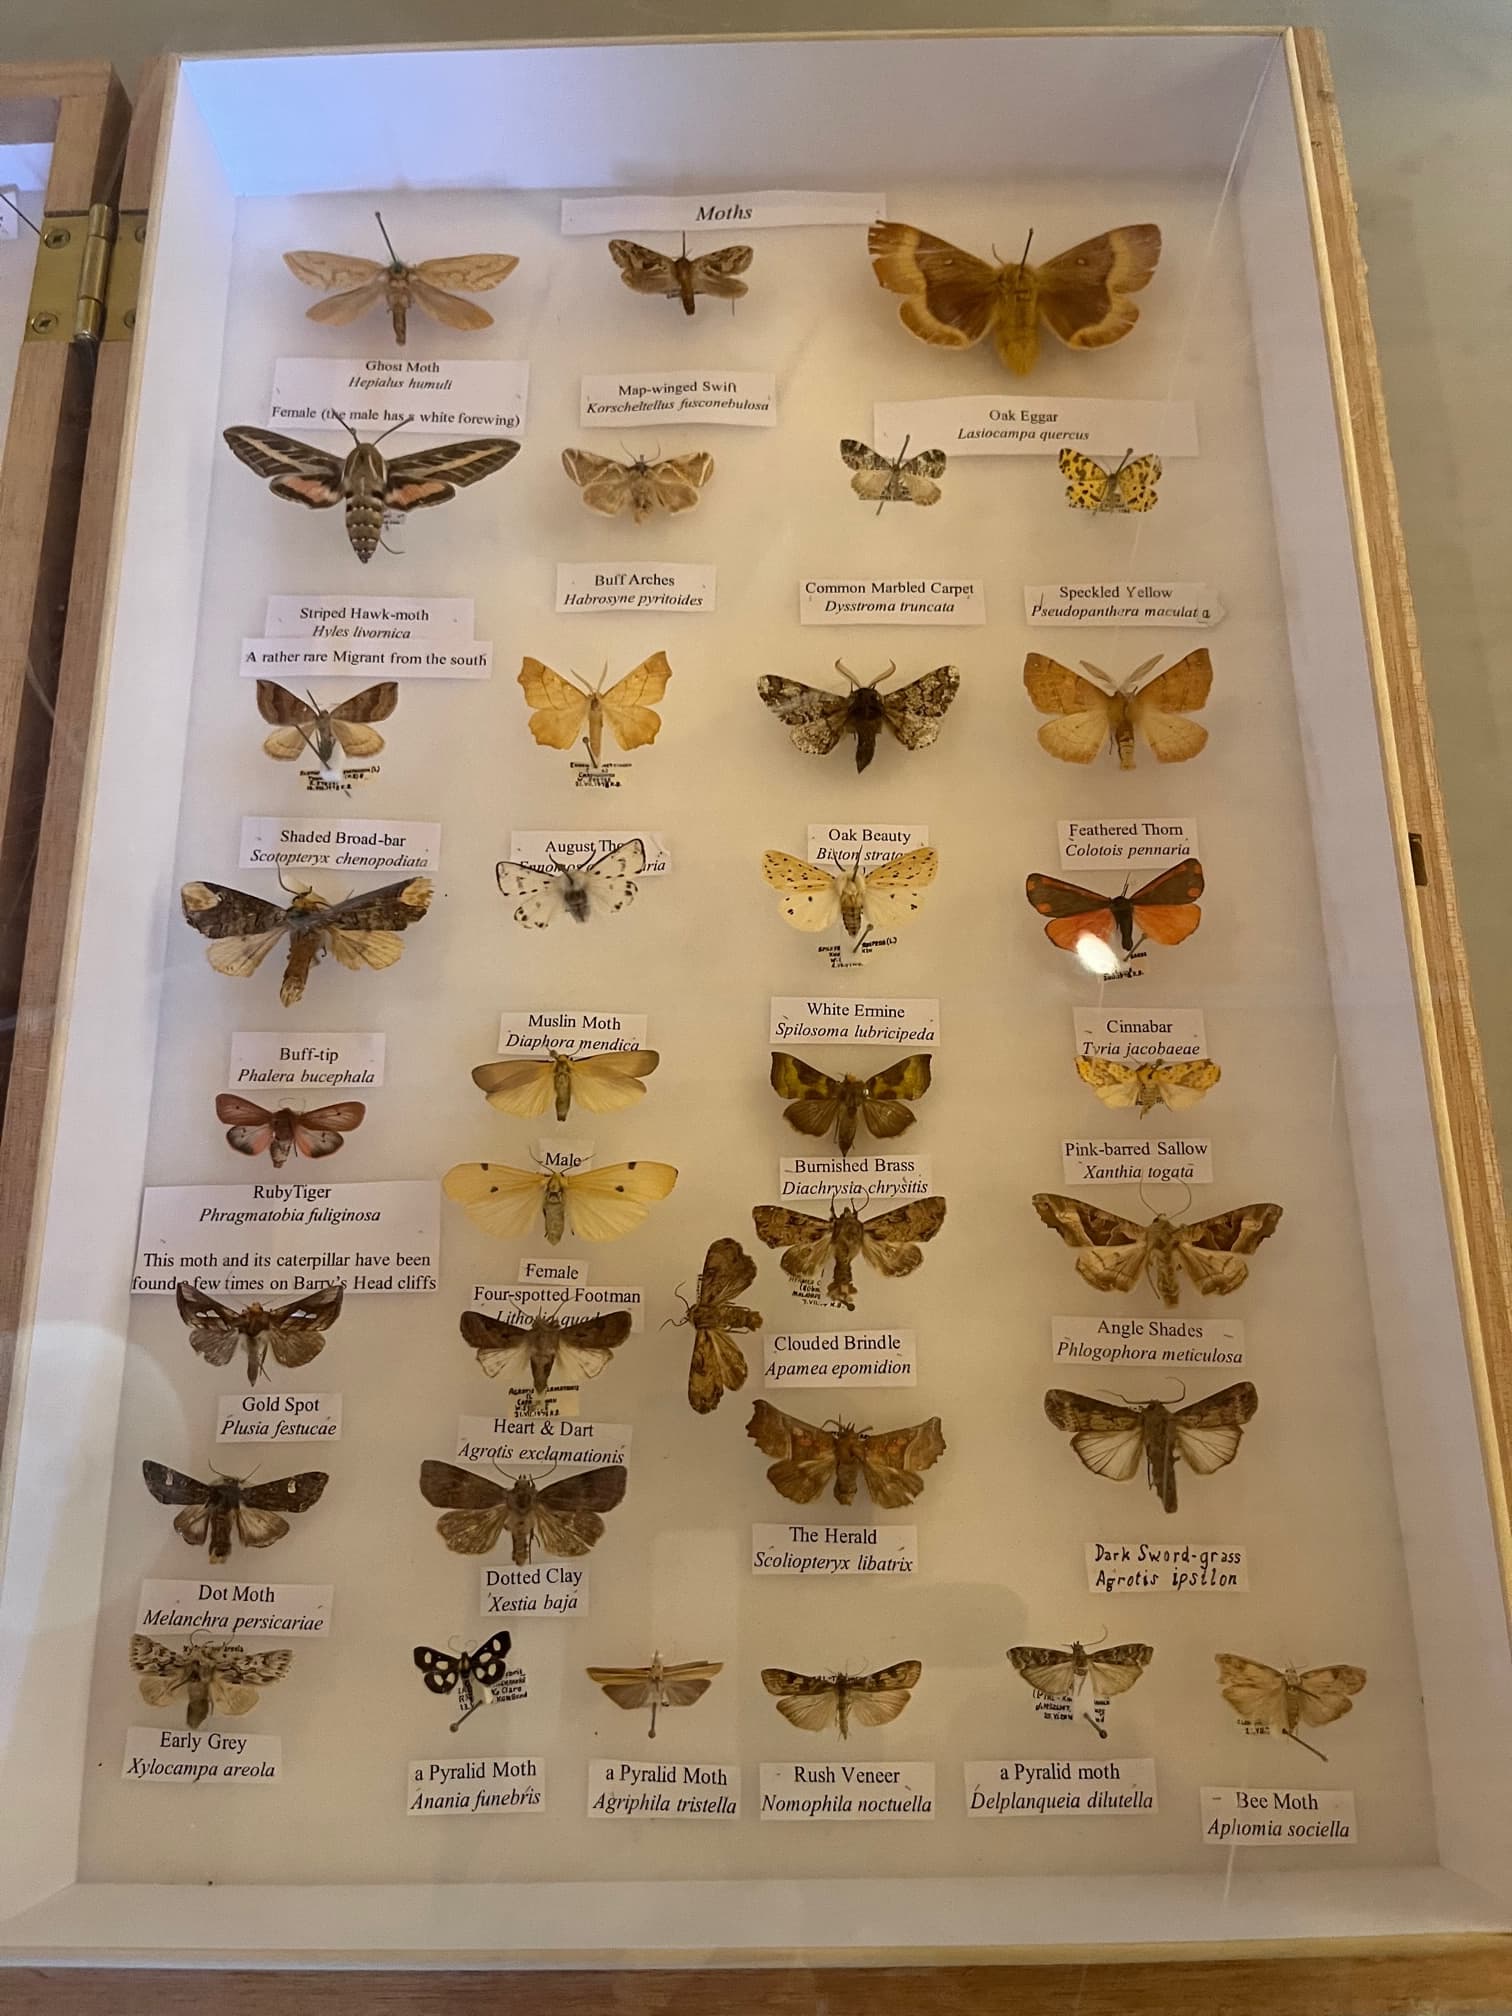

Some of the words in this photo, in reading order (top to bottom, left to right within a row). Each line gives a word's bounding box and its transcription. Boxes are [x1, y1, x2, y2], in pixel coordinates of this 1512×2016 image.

[696, 204, 752, 221] Moths
[366, 361, 402, 373] Ghost
[407, 362, 440, 373] Moth
[349, 377, 404, 390] Hepialus
[409, 378, 452, 390] humuli
[619, 382, 697, 398] Map-winged
[702, 382, 736, 393] Swift
[587, 399, 675, 413] Korscheltellus
[678, 398, 769, 411] fusconebulosa
[272, 406, 316, 418] Female
[350, 409, 378, 420] male
[421, 412, 454, 423] white
[458, 413, 520, 428] forewing)
[989, 410, 1016, 422] Oak
[1021, 411, 1058, 424] Eggar
[958, 428, 1036, 442] Lasiocampa
[1039, 429, 1089, 442] quercus
[595, 574, 627, 586] Buff
[629, 574, 675, 586] Arches
[805, 582, 865, 593] Common
[871, 582, 926, 593] Marbled
[931, 582, 973, 597] Carpet
[1060, 586, 1120, 600] Speckled
[1127, 586, 1172, 598] Yellow
[564, 594, 635, 606] Habrosyne
[638, 594, 703, 606] pyritoides
[825, 600, 895, 614] Dysstroma
[900, 601, 954, 612] truncata
[300, 607, 346, 620] Striped
[350, 608, 429, 621] Hawk-moth
[1032, 605, 1139, 620] Pseudopanthera
[312, 625, 349, 639] Hyles
[353, 626, 411, 639] livornica
[246, 652, 256, 662] A
[262, 651, 300, 662] rather
[303, 653, 327, 662] rare
[333, 651, 384, 666] Migrant
[391, 652, 422, 664] from
[426, 653, 445, 665] the
[451, 655, 487, 666] south
[829, 829, 857, 841] Oak
[862, 829, 911, 845] Beauty
[1069, 824, 1137, 836] Feathered
[1141, 823, 1183, 835] Thorn
[280, 830, 331, 843] Shaded
[336, 832, 406, 847] Broad-bar
[545, 841, 596, 855] August
[1066, 843, 1123, 857] Colotois
[1127, 844, 1190, 859] pennaria
[250, 850, 330, 865] Scotopteryx
[336, 852, 428, 869] chenopodiata
[808, 1002, 849, 1016] White
[855, 1004, 905, 1018] Ermine
[528, 1014, 576, 1027] Muslin
[583, 1016, 621, 1030] Moth
[1107, 1020, 1173, 1033] Cinnabar
[776, 1023, 849, 1038] Spilosoma
[854, 1025, 934, 1043] lubricipeda
[506, 1034, 575, 1050] Diaphora
[579, 1037, 639, 1051] mendica
[1123, 1042, 1200, 1058] jacobaeae
[280, 1047, 338, 1064] Buff-tip
[238, 1069, 295, 1082] Phalera
[301, 1069, 375, 1086] bucephala
[1065, 1142, 1150, 1156] Pink-barred
[1158, 1142, 1208, 1155] Sallow
[546, 1152, 582, 1166] Male
[795, 1159, 868, 1173] Burnished
[875, 1159, 915, 1172] Brass
[1083, 1165, 1142, 1179] Xanthia
[1148, 1167, 1194, 1181] togata
[782, 1181, 862, 1196] Diachrysia
[868, 1180, 928, 1197] chrysitis
[199, 1208, 304, 1225] Phragmatobia
[306, 1208, 381, 1225] fuliginosa
[144, 1253, 174, 1267] This
[180, 1255, 218, 1267] moth
[223, 1255, 248, 1267] and
[254, 1255, 271, 1267] its
[277, 1252, 350, 1270] caterpillar
[356, 1252, 390, 1267] have
[396, 1252, 430, 1266] been
[526, 1263, 578, 1279] Female
[132, 1276, 176, 1290] found
[194, 1276, 220, 1290] few
[226, 1276, 264, 1290] times
[270, 1281, 288, 1289] on
[354, 1276, 392, 1289] Head
[398, 1276, 436, 1289] cliffs
[474, 1287, 569, 1304] Four-spotted
[575, 1288, 640, 1303] Footman
[1097, 1320, 1143, 1338] Angle
[1149, 1322, 1203, 1337] Shades
[774, 1335, 839, 1351] Clouded
[844, 1335, 900, 1349] Brindle
[1058, 1342, 1157, 1362] Phlogophora
[1162, 1347, 1242, 1363] meticulosa
[765, 1361, 828, 1380] Apamea
[832, 1359, 910, 1378] epomidion
[242, 1396, 280, 1412] Gold
[285, 1397, 320, 1416] Spot
[220, 1420, 269, 1435] Plusia
[271, 1420, 336, 1439] festucae
[494, 1418, 535, 1434] Heart
[541, 1420, 554, 1435] &
[560, 1422, 593, 1437] Dart
[458, 1442, 513, 1461] Agrotis
[519, 1445, 624, 1464] exclamationis
[789, 1527, 818, 1542] The
[825, 1528, 877, 1544] Herald
[754, 1552, 850, 1574] Scoliopteryx
[858, 1555, 913, 1572] libatrix
[1095, 1544, 1130, 1562] Dark
[1138, 1544, 1241, 1569] Sword-grass
[487, 1569, 540, 1586] Dotted
[546, 1568, 582, 1587] Clay
[1096, 1570, 1159, 1592] Agrotis
[199, 1584, 227, 1601] Dot
[232, 1585, 275, 1603] Moth
[488, 1596, 537, 1612] Xestia
[544, 1594, 577, 1613] baja
[143, 1610, 228, 1627] Melanchra
[233, 1615, 323, 1633] persicariae
[160, 1731, 201, 1752] Early
[208, 1733, 247, 1754] Grey
[127, 1757, 218, 1783] Xylocampa
[223, 1762, 275, 1777] areola
[415, 1769, 423, 1781] a
[429, 1762, 485, 1784] Pyralid
[493, 1760, 536, 1778] Moth
[606, 1768, 614, 1780] a
[619, 1764, 676, 1785] Pyralid
[683, 1767, 727, 1785] Moth
[794, 1766, 835, 1783] Rush
[842, 1767, 900, 1783] Veneer
[1000, 1768, 1008, 1780] a
[1014, 1763, 1071, 1784] Pyralid
[1078, 1763, 1120, 1780] moth
[410, 1792, 470, 1810] Anania
[472, 1788, 541, 1812] funebris
[592, 1792, 670, 1814] Agriphila
[677, 1796, 736, 1814] tristella
[762, 1795, 852, 1816] Nomophila
[858, 1795, 932, 1812] noctuella
[970, 1792, 1080, 1813] Delplanqueia
[1087, 1791, 1153, 1808] dilutella
[1236, 1792, 1268, 1809] Bee
[1273, 1793, 1318, 1810] Moth
[1208, 1818, 1282, 1839] Aphomia
[1288, 1820, 1349, 1837] sociella
